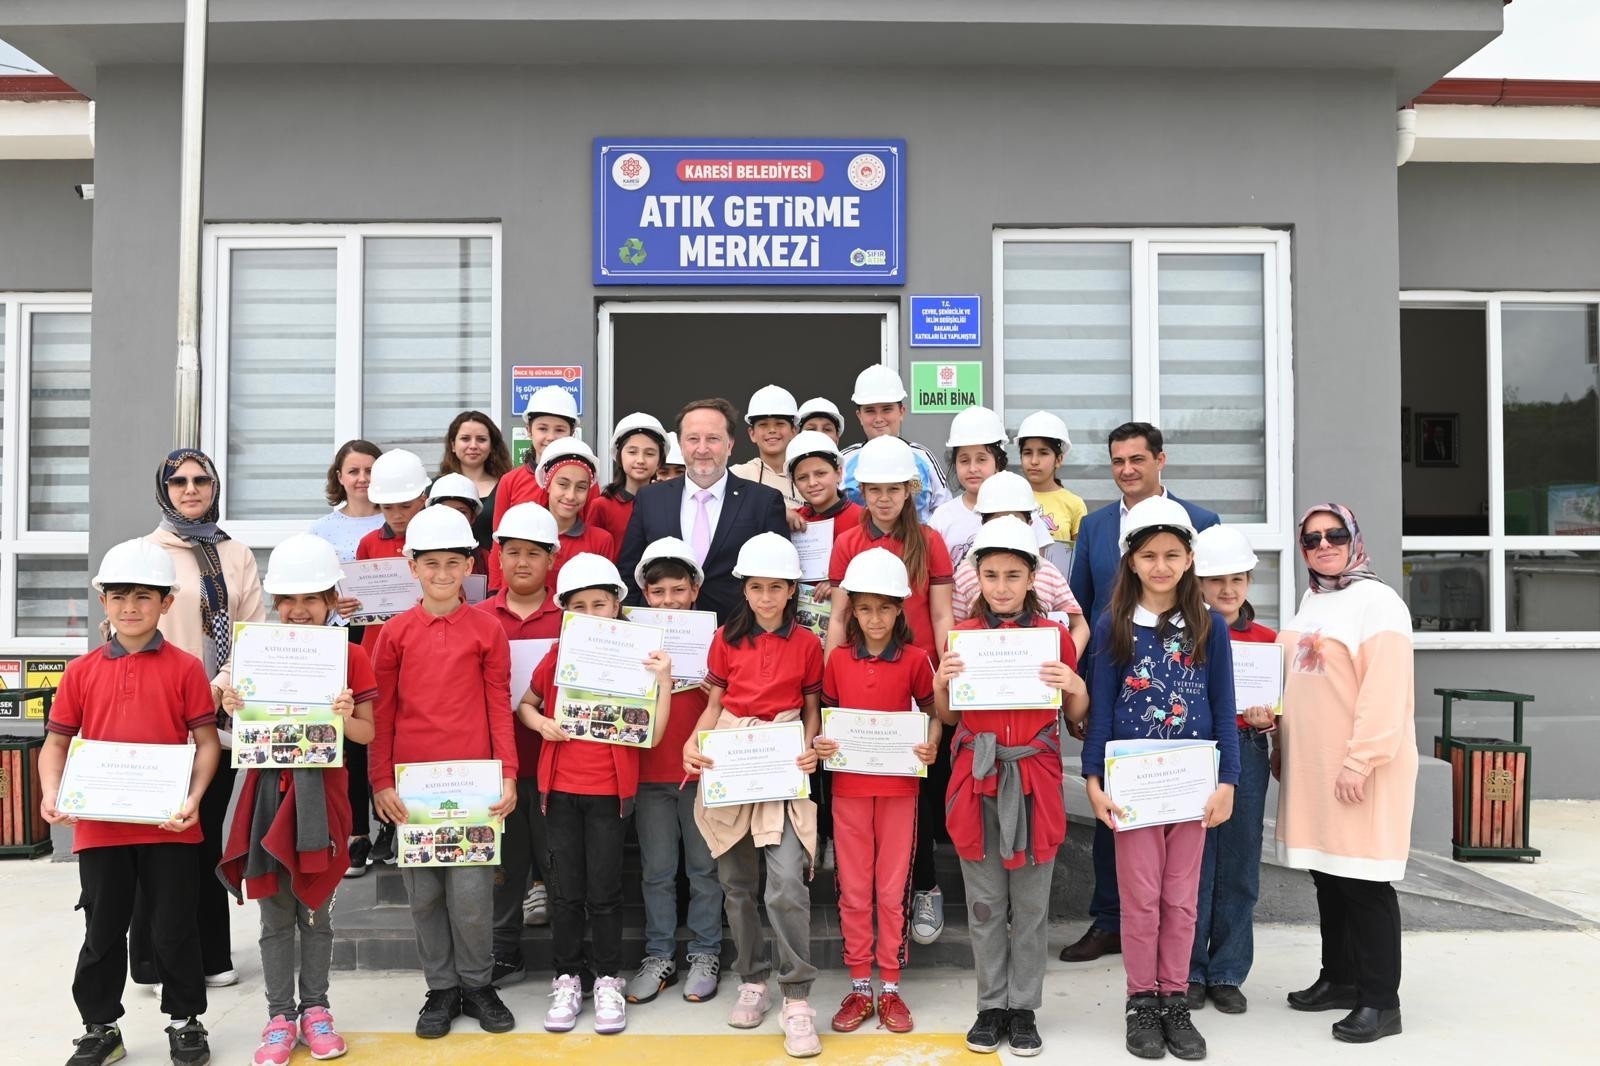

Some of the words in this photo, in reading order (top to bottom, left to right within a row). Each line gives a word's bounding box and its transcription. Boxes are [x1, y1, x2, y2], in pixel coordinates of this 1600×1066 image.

[685, 162, 733, 178] KARESİ
[736, 162, 812, 178] BELEDİYESİ
[639, 195, 715, 228] ATIK
[724, 196, 860, 228] GETİRME
[680, 235, 820, 267] MERKEZİ
[919, 389, 947, 406] İDARİ
[950, 389, 976, 406] BİNA
[38, 662, 64, 670] DİKKAT!
